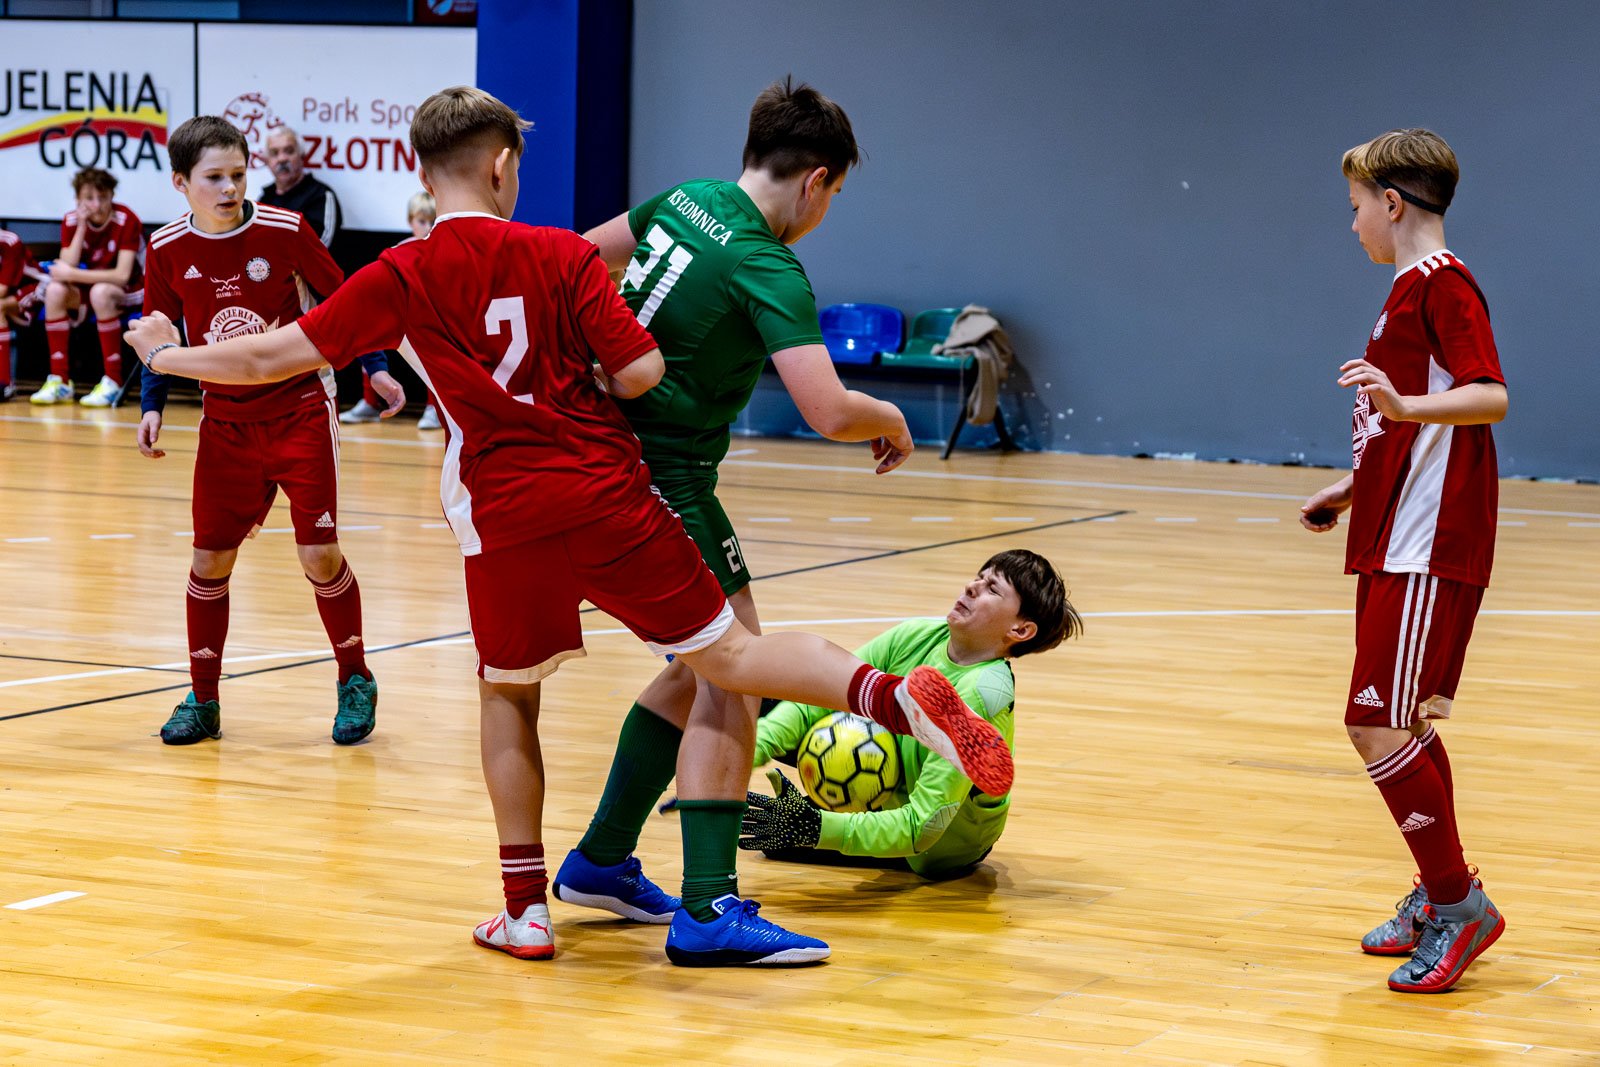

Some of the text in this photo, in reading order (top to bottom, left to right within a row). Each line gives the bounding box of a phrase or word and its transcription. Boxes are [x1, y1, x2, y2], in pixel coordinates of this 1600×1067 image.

[0, 70, 162, 116] JELENIA
[303, 97, 358, 123] Park
[39, 117, 161, 170] GÓRA
[676, 197, 733, 246] ŁOMNICA
[214, 308, 254, 325] PIZZERIA
[484, 295, 535, 406] 2
[721, 535, 745, 574] 21
[1353, 696, 1384, 708] adidas
